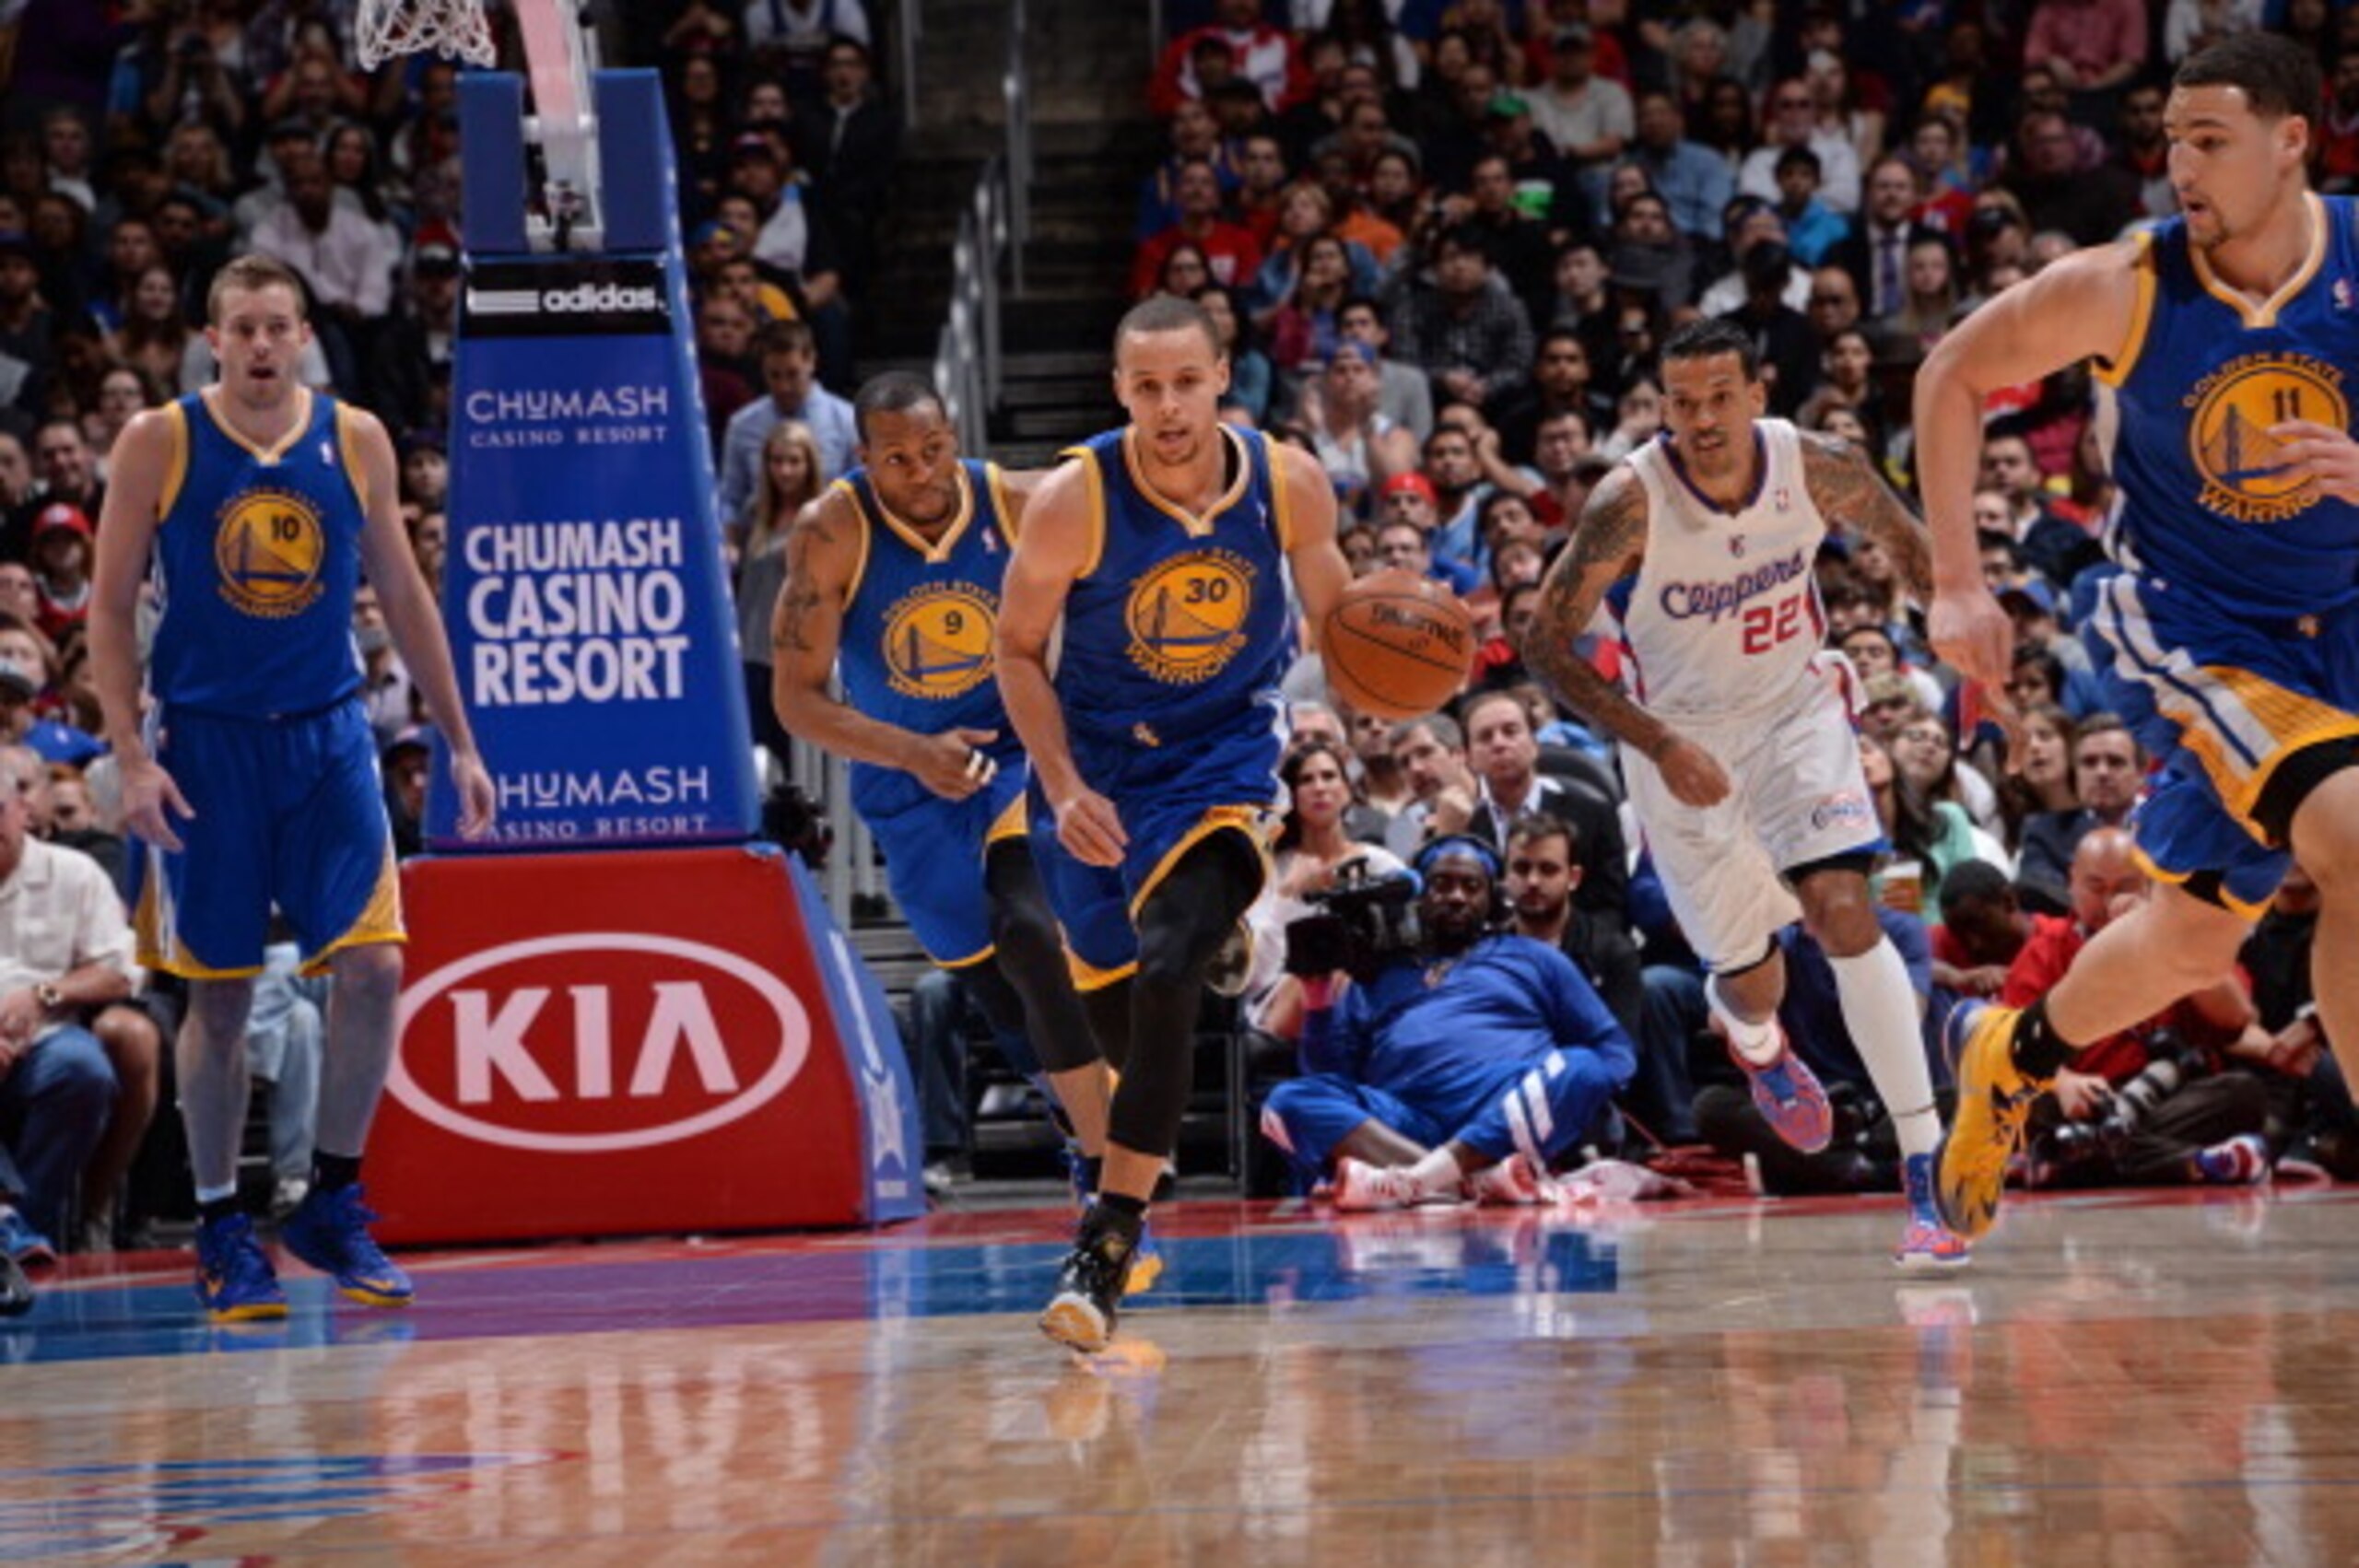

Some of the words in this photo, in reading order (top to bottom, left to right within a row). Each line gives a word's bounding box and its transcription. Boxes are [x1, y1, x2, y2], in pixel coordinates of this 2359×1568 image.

[466, 385, 669, 424] CHUMASH
[2273, 387, 2301, 424] 11
[470, 429, 565, 449] CASINO
[576, 425, 669, 445] RESORT
[271, 515, 301, 542] 10
[465, 518, 684, 573] CHUMASH
[467, 568, 685, 639] CASINO
[1184, 577, 1231, 603] 30
[1660, 546, 1806, 623] Clippers
[945, 610, 963, 636] 9
[1742, 593, 1802, 656] 22
[473, 635, 690, 708] RESORT
[498, 765, 710, 809] HUMASH
[487, 819, 578, 842] ASINO
[594, 813, 710, 838] RESORT
[447, 979, 739, 1103] KIA
